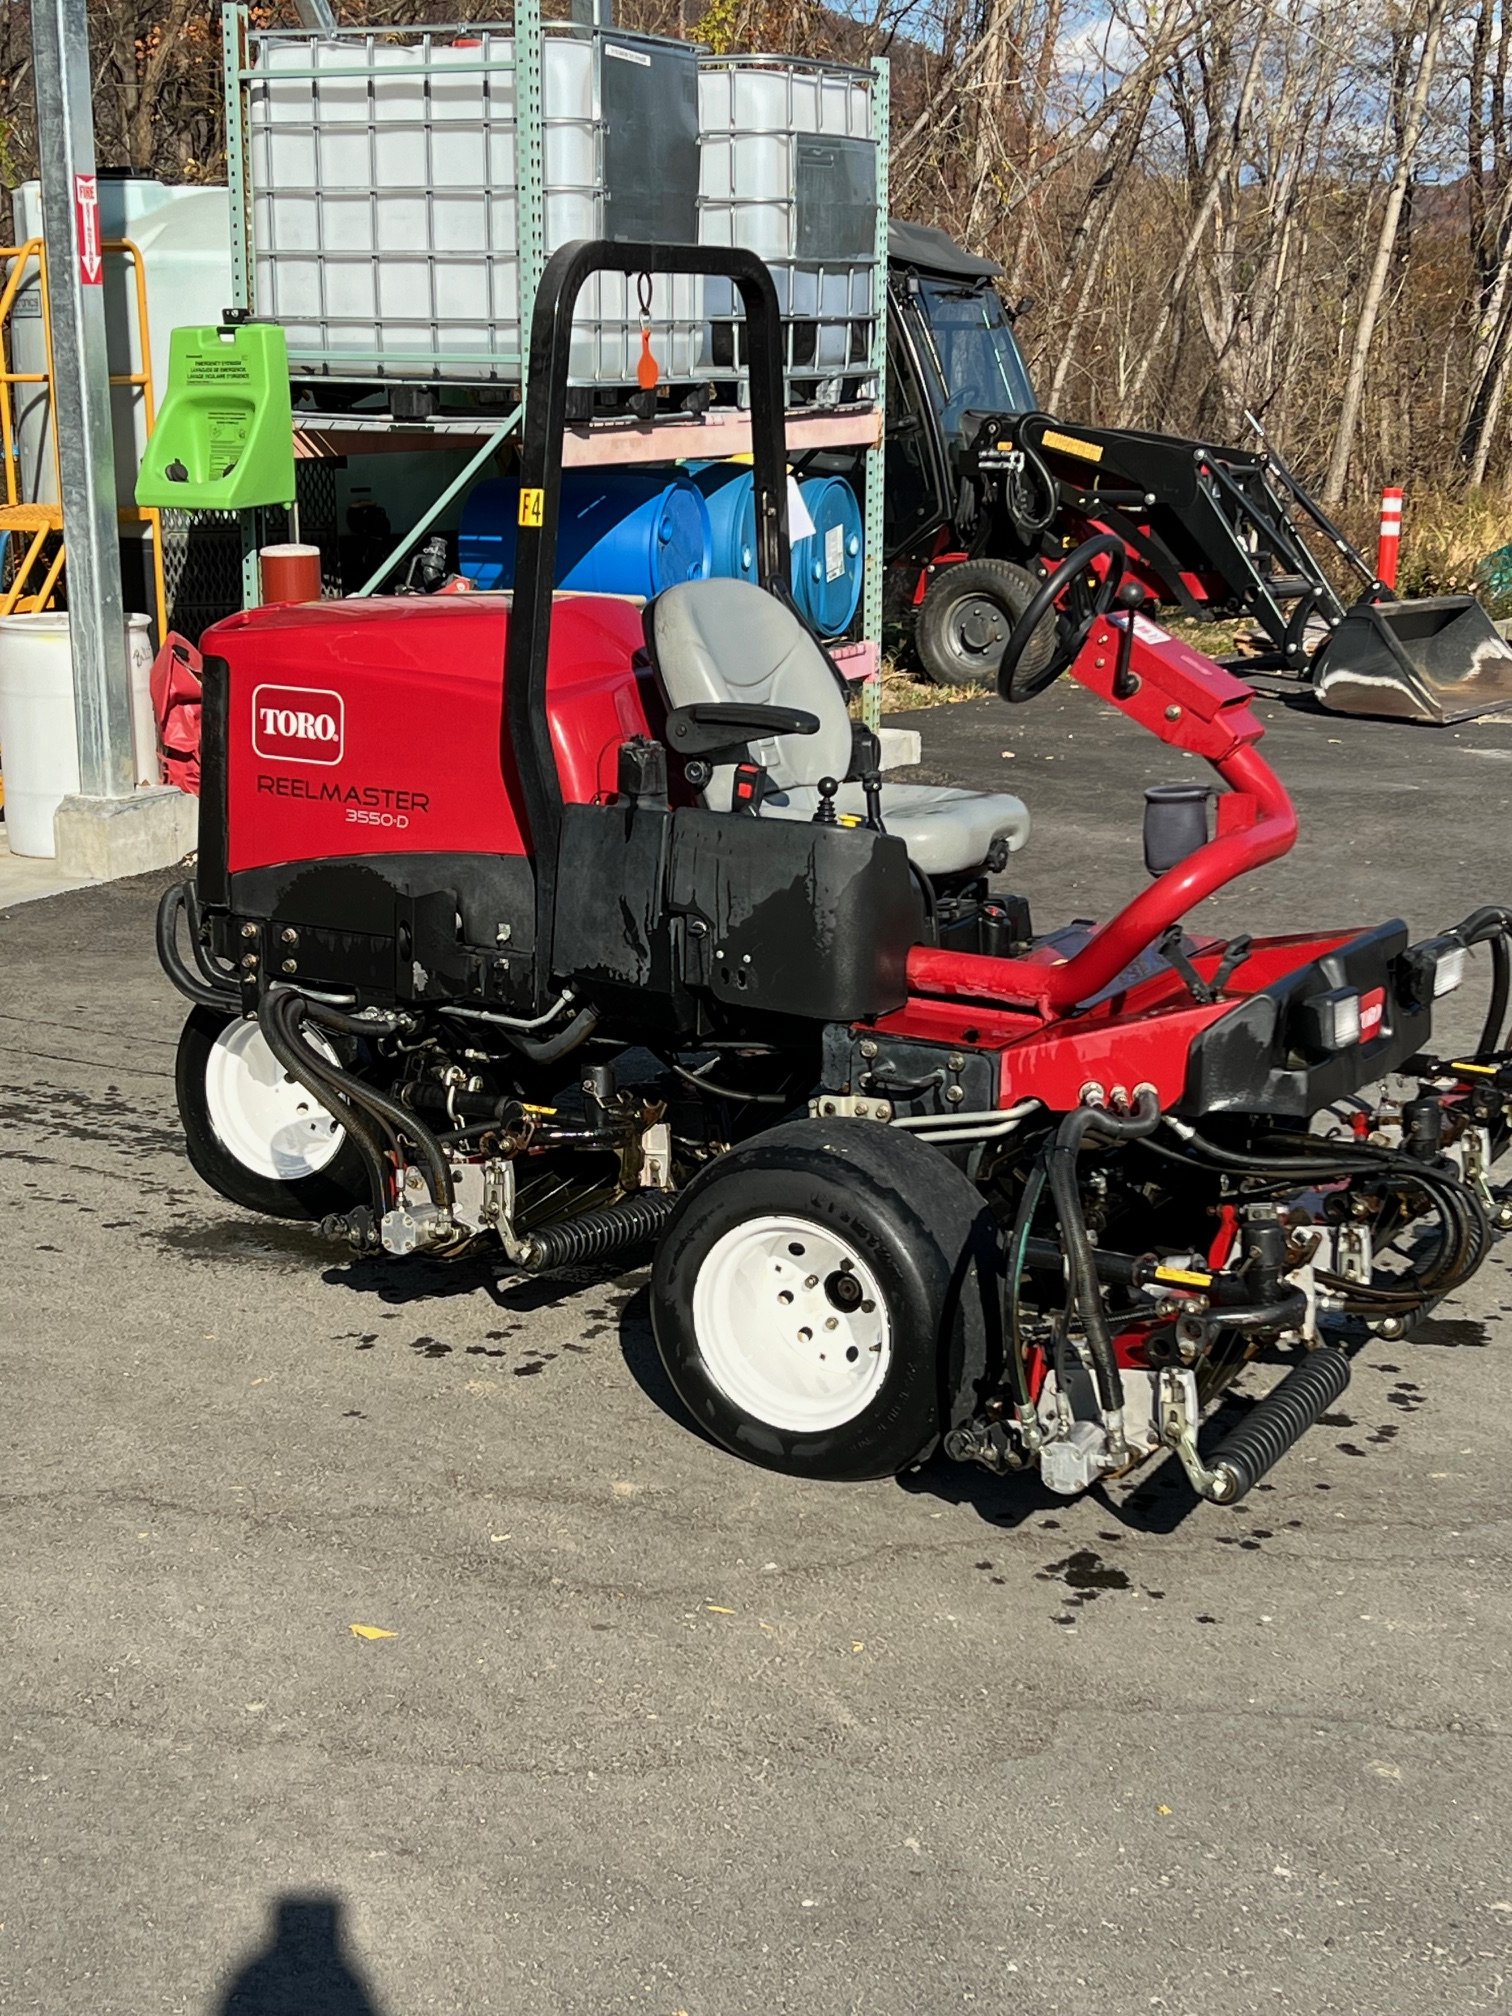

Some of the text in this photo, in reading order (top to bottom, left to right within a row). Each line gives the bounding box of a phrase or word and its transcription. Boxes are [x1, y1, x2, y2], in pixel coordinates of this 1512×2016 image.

[79, 185, 94, 199] FIRE
[522, 491, 542, 524] F4
[257, 774, 430, 813] REELMASTER
